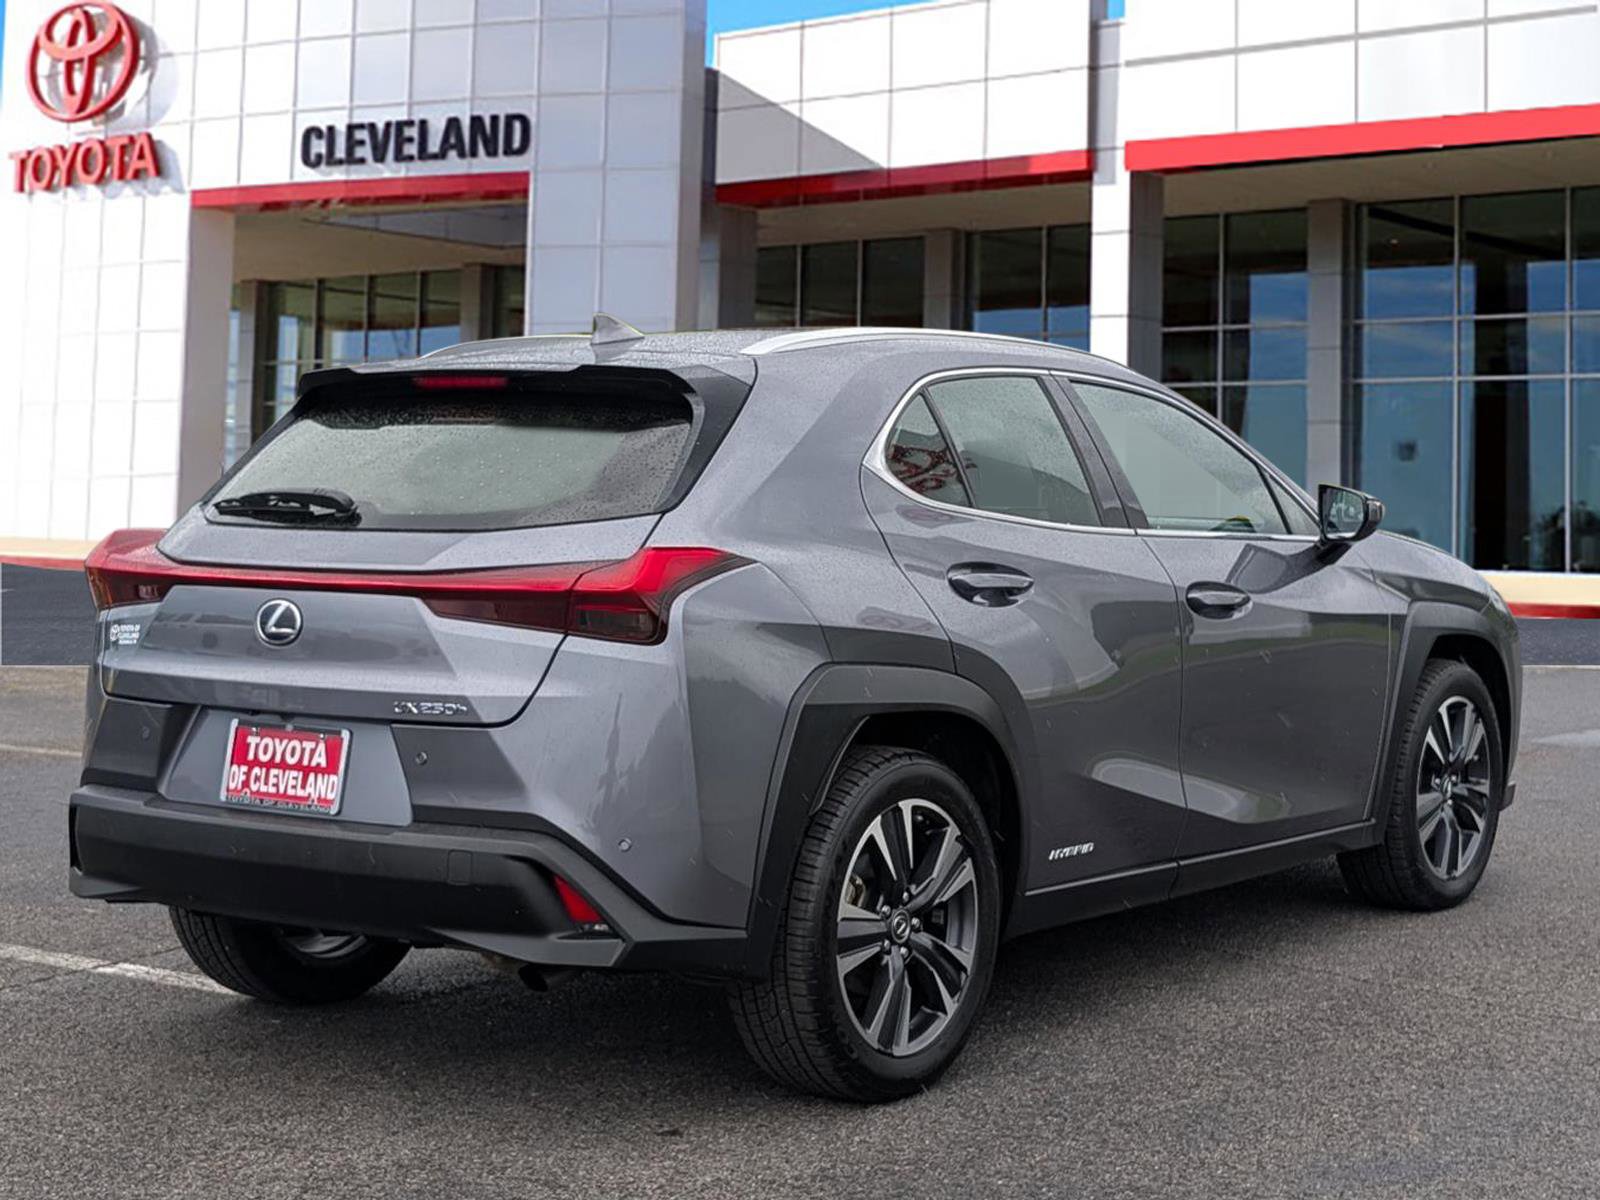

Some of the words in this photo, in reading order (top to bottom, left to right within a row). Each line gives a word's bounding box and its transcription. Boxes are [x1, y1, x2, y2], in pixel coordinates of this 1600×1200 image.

[8, 132, 161, 193] TOYOTA
[301, 113, 531, 169] CLEVELAND
[246, 735, 327, 768] TOYOTA
[228, 764, 249, 791] OF
[249, 766, 338, 800] CLEVELAND
